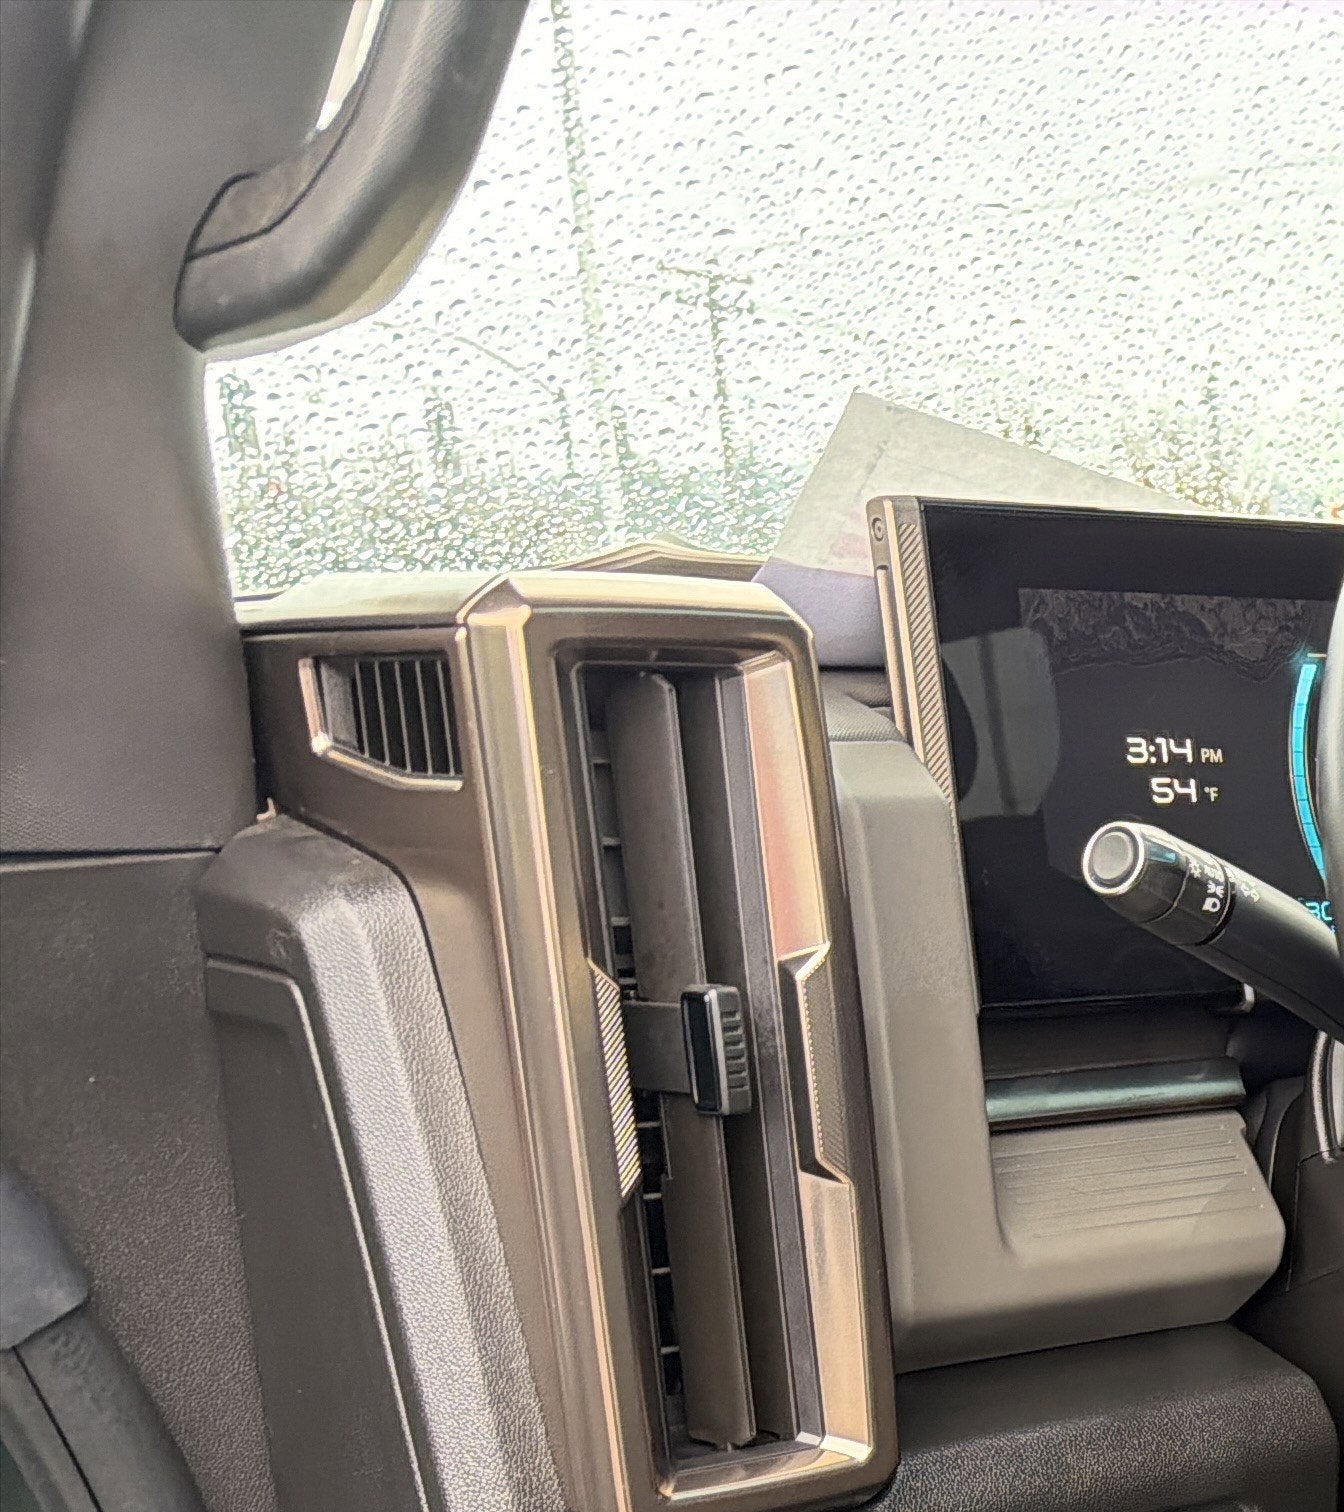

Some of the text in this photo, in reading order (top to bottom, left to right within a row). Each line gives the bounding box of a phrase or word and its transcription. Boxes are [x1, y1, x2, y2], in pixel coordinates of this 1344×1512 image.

[1126, 736, 1223, 764] 3:14 PM
[1150, 777, 1198, 804] 54
